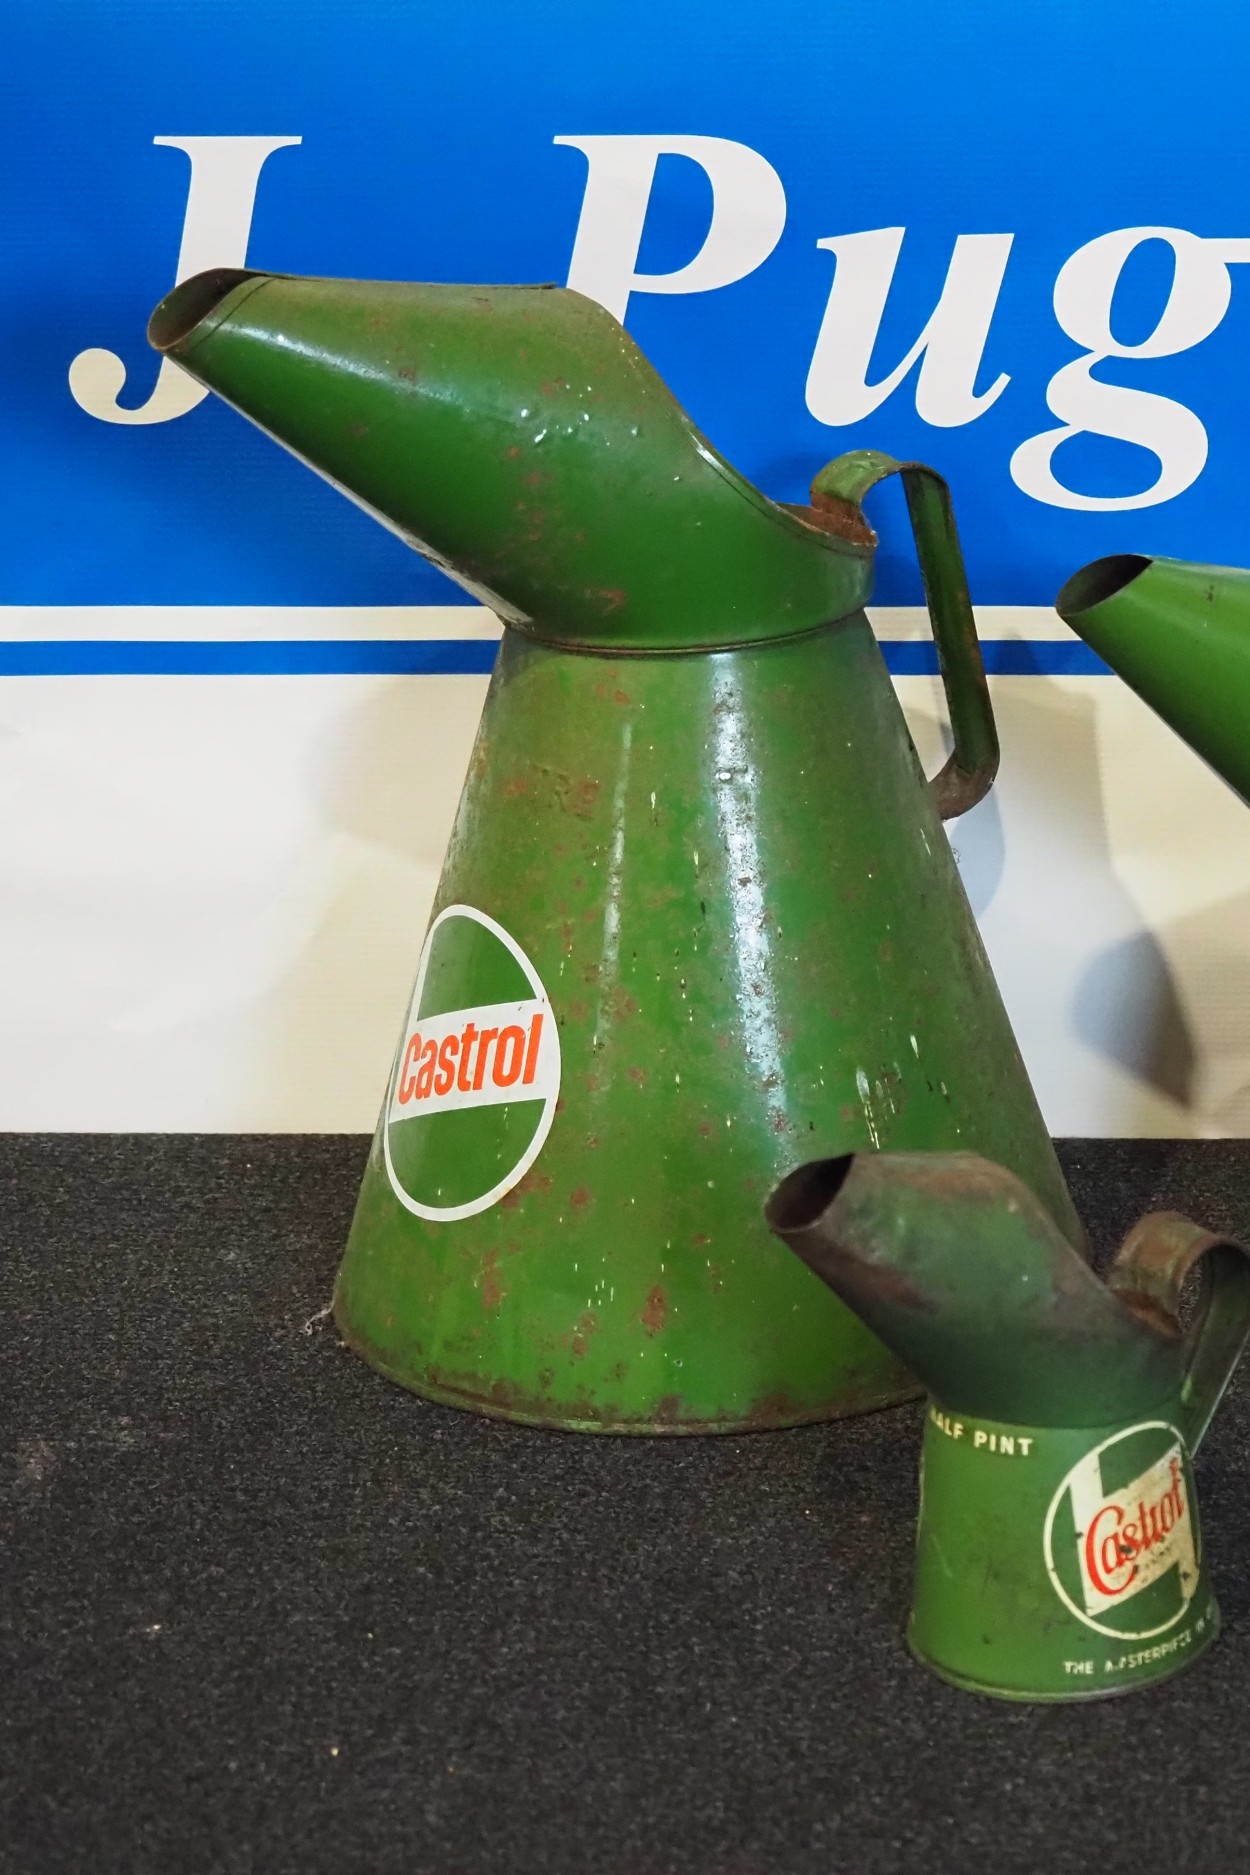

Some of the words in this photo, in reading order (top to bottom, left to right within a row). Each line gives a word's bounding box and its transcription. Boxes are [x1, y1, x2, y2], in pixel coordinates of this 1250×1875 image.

[398, 1013, 544, 1105] Castrol
[973, 1430, 1034, 1456] PINT
[1085, 1456, 1184, 1597] Castrol
[1063, 1659, 1095, 1675] THE
